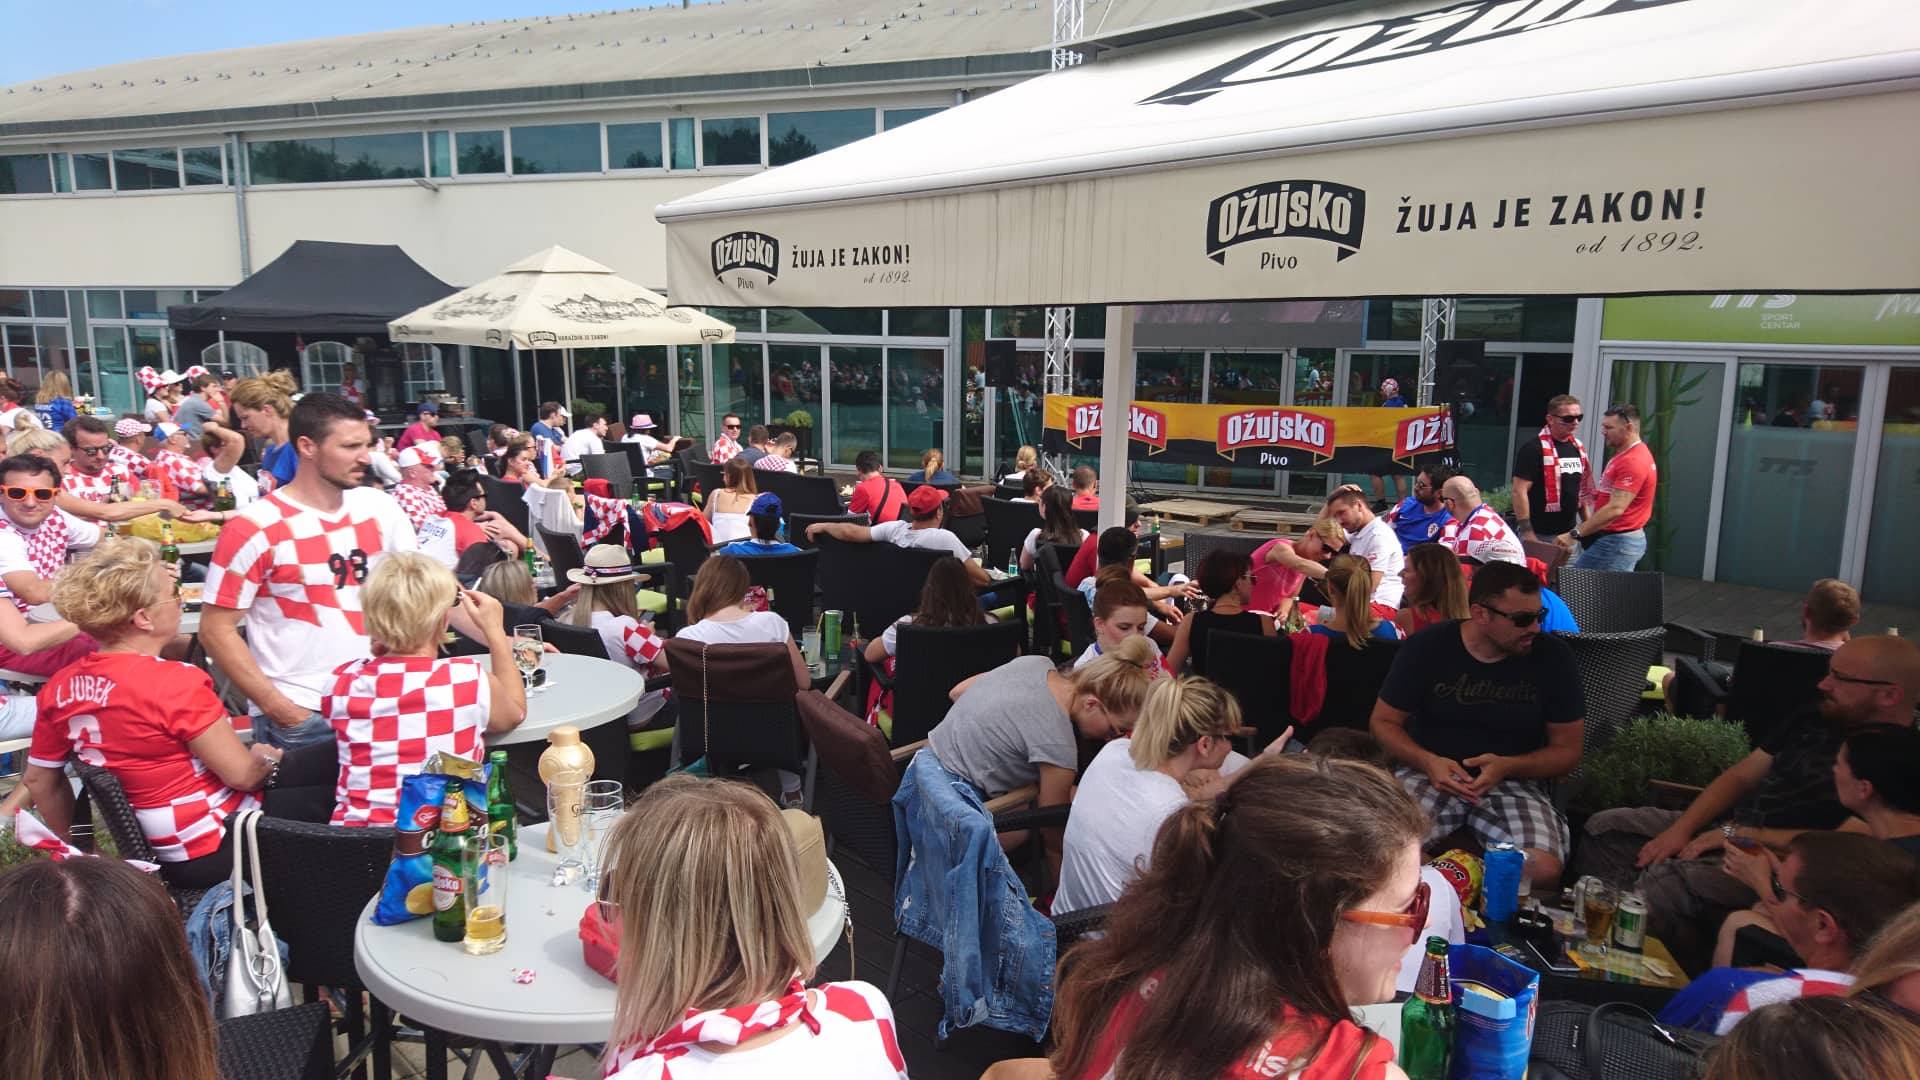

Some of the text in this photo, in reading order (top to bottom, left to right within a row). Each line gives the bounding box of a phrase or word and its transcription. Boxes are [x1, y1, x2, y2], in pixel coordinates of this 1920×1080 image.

[1218, 183, 1352, 243] Ožujsko
[1396, 187, 1705, 233] ŽUJA JE ZAKON!
[715, 233, 774, 271] Ožujsko
[1575, 231, 1704, 254] od 1892.
[792, 244, 910, 268] ŽUJA JE ZAKON!
[1260, 251, 1298, 270] Pivo
[737, 276, 754, 289] Pivo
[863, 270, 911, 284] od 1892.
[1760, 321, 1800, 329] CENTAR
[1761, 313, 1793, 321] SPORT
[1075, 405, 1158, 439] Ožko
[1226, 411, 1326, 447] Ožujsko
[1260, 452, 1288, 466] Pivo
